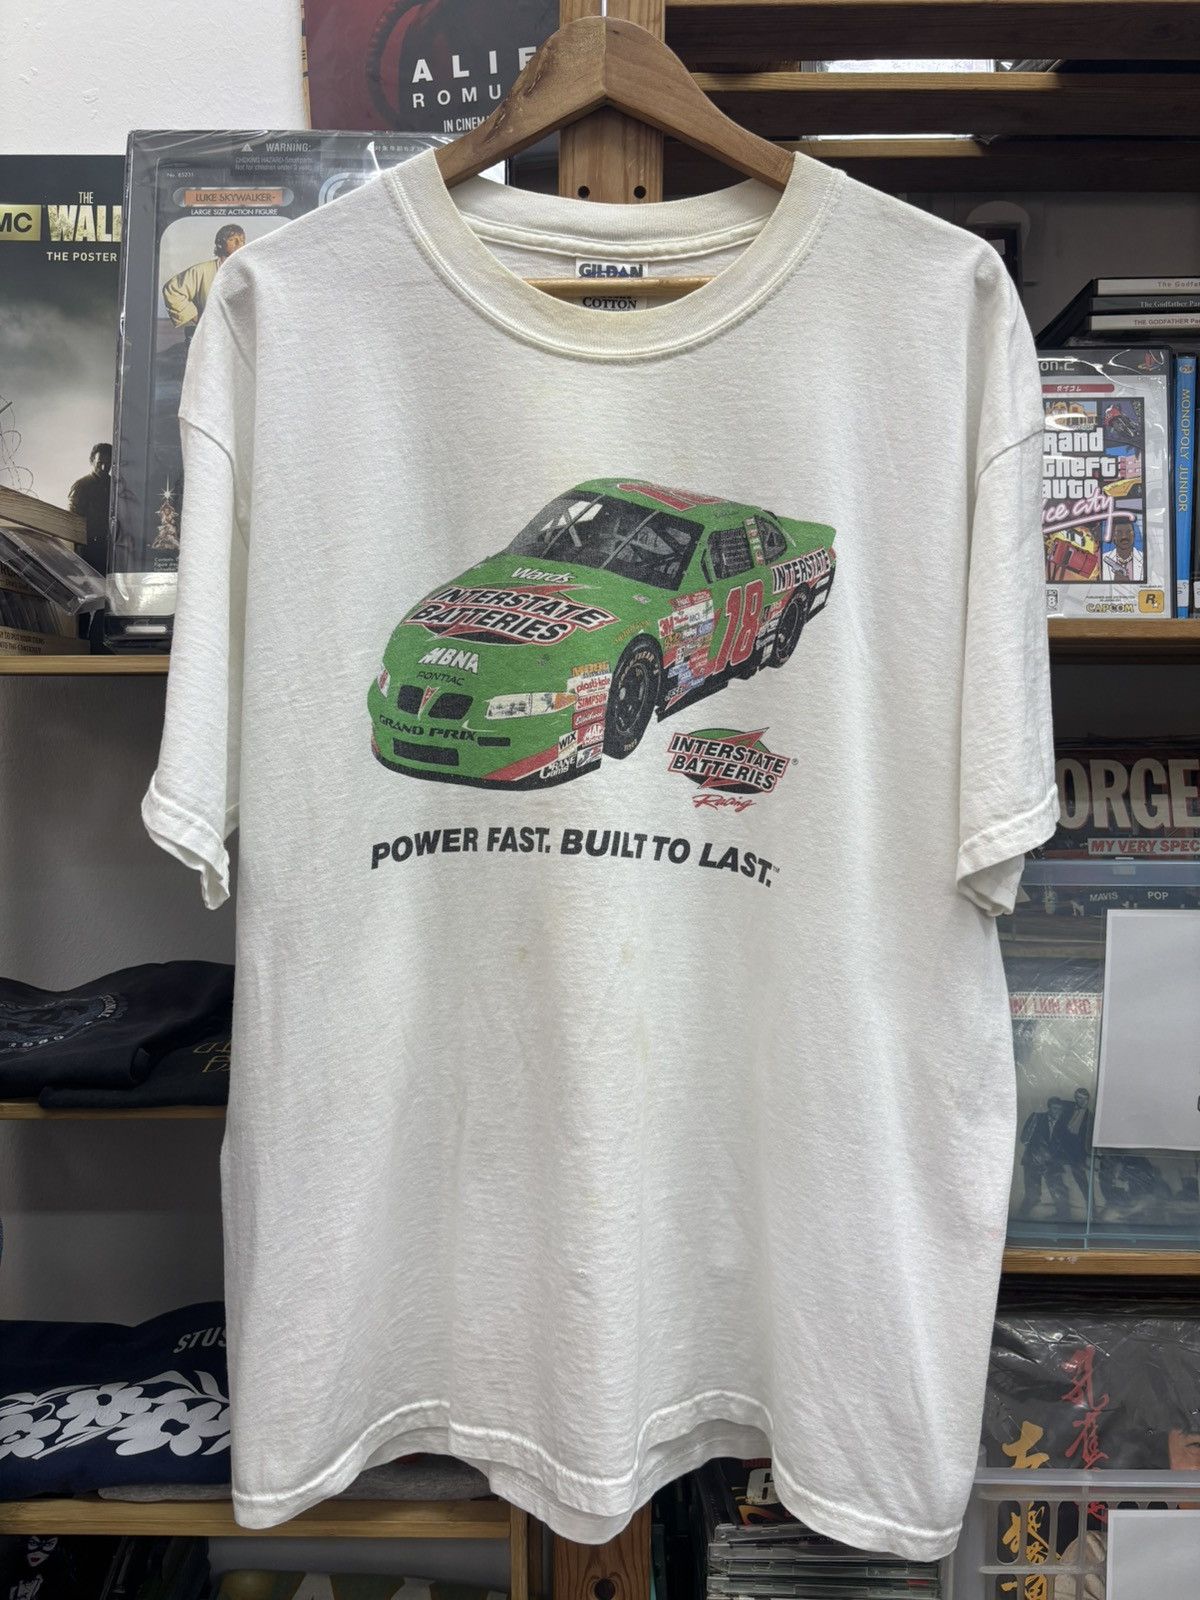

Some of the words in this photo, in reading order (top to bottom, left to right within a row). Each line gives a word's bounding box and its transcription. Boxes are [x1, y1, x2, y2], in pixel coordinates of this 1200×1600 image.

[443, 119, 454, 133] IN
[265, 142, 312, 152] WARNING:
[79, 191, 94, 204] THE
[195, 193, 216, 202] LUKE
[191, 208, 211, 216] LARGE
[213, 208, 227, 216] SIZE
[228, 208, 254, 216] ACTION
[255, 208, 278, 216] FIGURE
[46, 251, 69, 261] THE
[73, 252, 118, 262] POSTER
[578, 263, 644, 278] GILDAN
[582, 296, 637, 310] COTTON
[1180, 389, 1190, 460] MONOPOLY
[1178, 464, 1189, 513] JUNIOR
[511, 566, 575, 584] Wards
[772, 549, 830, 594] INTERSTATE
[434, 587, 609, 628] INTERSTATE
[1085, 603, 1135, 613] CAPCOM
[410, 604, 569, 642] BATTERIES
[713, 579, 764, 675] 18
[418, 647, 480, 675] MBNA
[416, 671, 465, 686] PONTIAC
[379, 714, 425, 736] GRAND
[428, 727, 477, 741] PRIX
[559, 731, 576, 750] WIX
[672, 736, 786, 774] INTERSTATE
[672, 754, 775, 790] BATTERIES
[692, 793, 756, 812] Racing
[371, 827, 479, 870] POWER
[486, 826, 551, 853] FAST.
[560, 828, 648, 859] BUILT
[653, 835, 691, 864] TO
[1091, 839, 1115, 852] MY
[1118, 839, 1157, 853] VERY
[1089, 891, 1119, 902] MAVIS
[1147, 891, 1169, 901] POP
